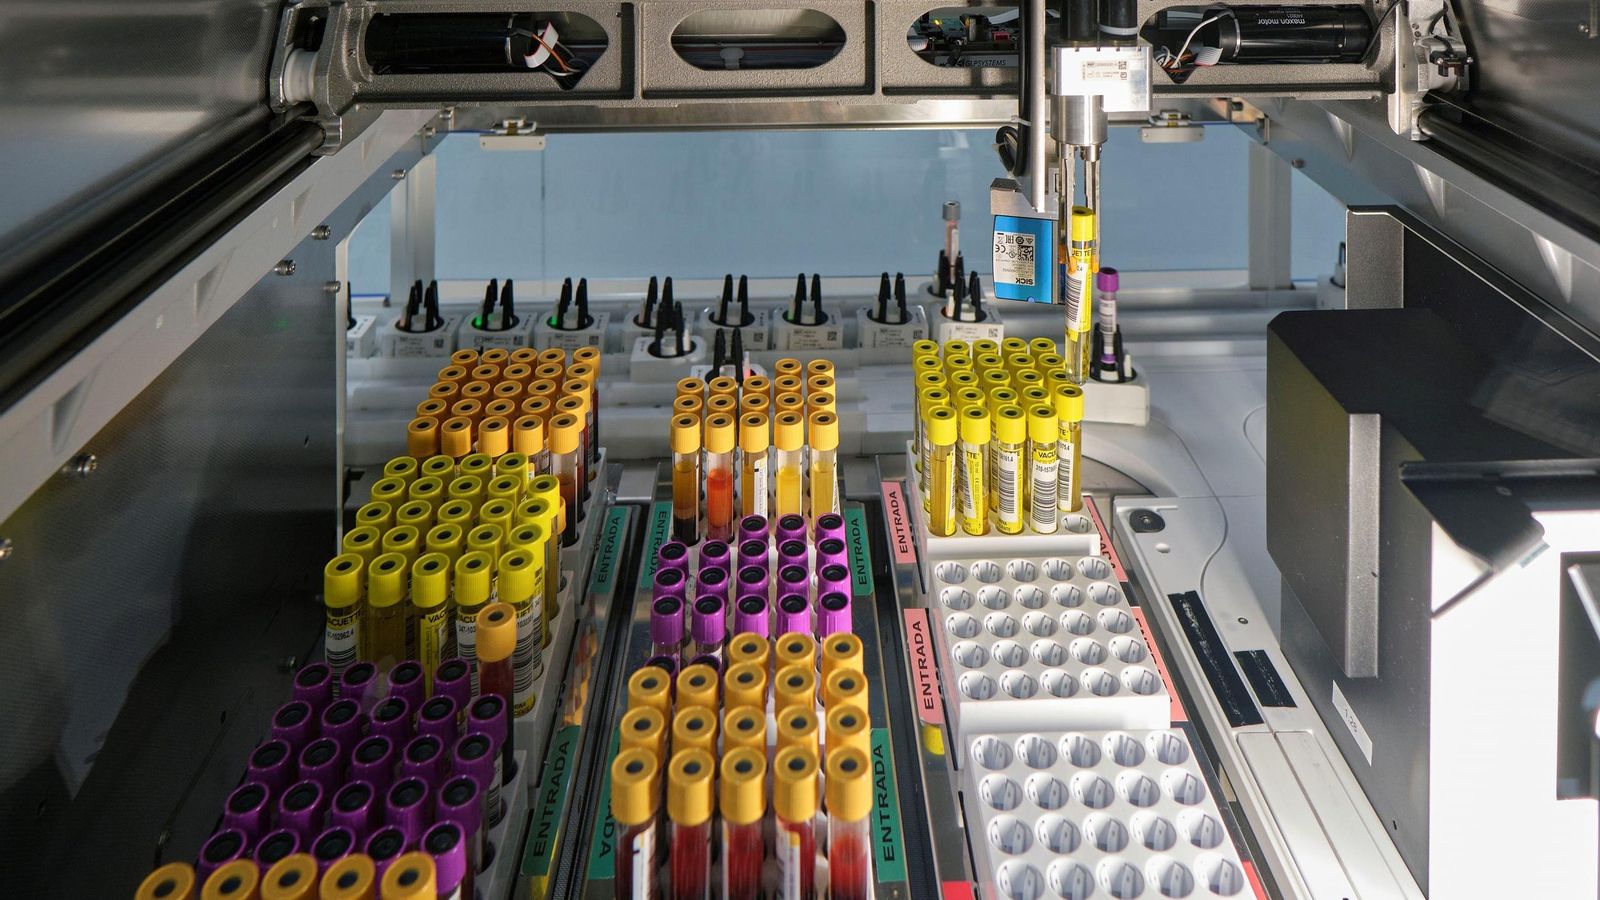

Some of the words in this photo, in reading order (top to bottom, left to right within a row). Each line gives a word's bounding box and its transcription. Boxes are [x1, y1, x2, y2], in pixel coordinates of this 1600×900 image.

[1015, 277, 1034, 285] SICK
[597, 517, 620, 583] ENTRADA
[851, 518, 868, 585] ENTRADA
[889, 490, 909, 554] ENTRADA
[912, 620, 935, 710] ENTRADA
[533, 740, 570, 857] ENTRADA
[873, 744, 895, 862] ENTRADA
